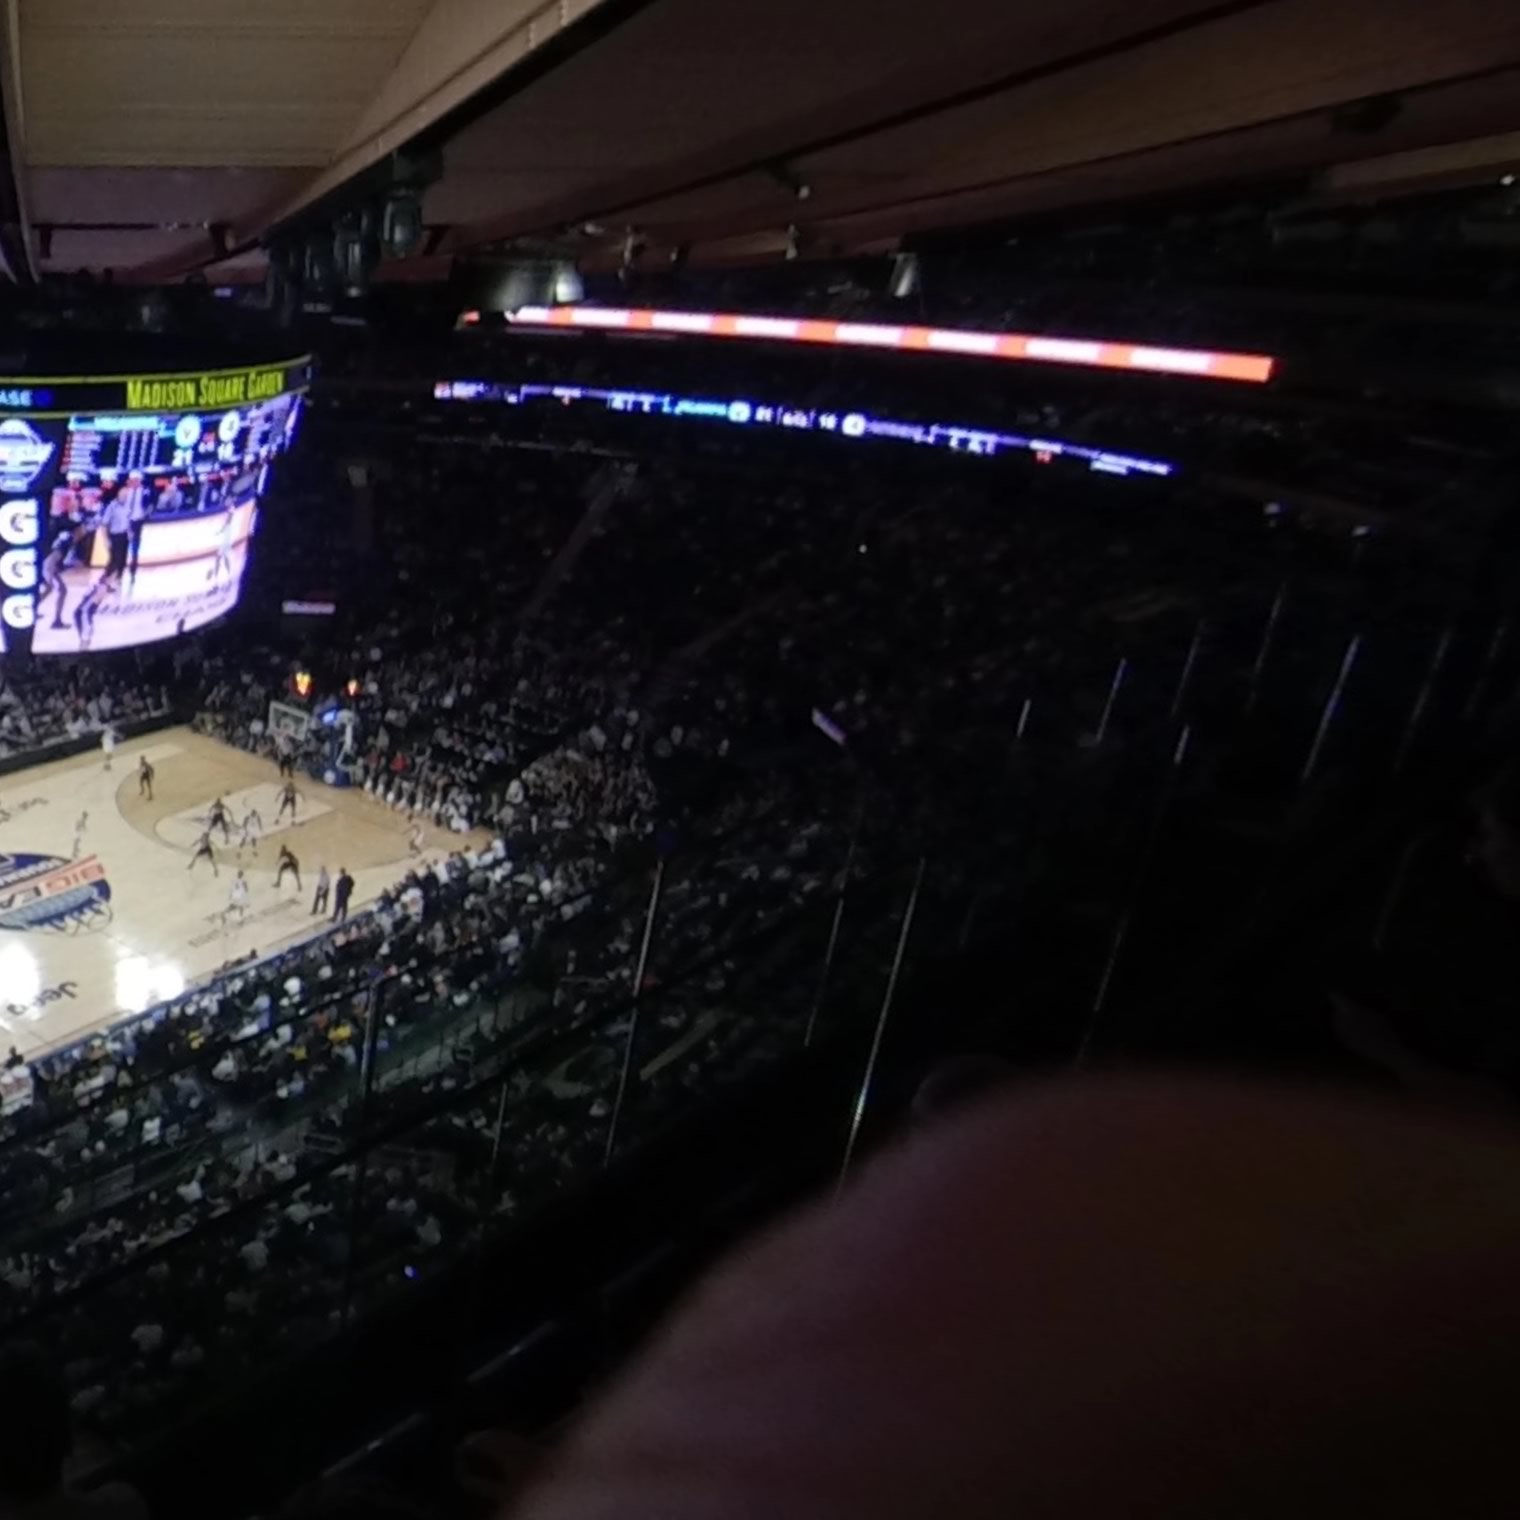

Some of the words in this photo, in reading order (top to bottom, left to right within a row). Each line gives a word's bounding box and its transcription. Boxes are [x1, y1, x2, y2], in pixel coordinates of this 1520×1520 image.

[127, 379, 196, 409] MADISON
[199, 375, 246, 406] SQUARE
[247, 370, 285, 400] GARDEN
[1, 594, 36, 629] G
[46, 862, 107, 892] BIG
